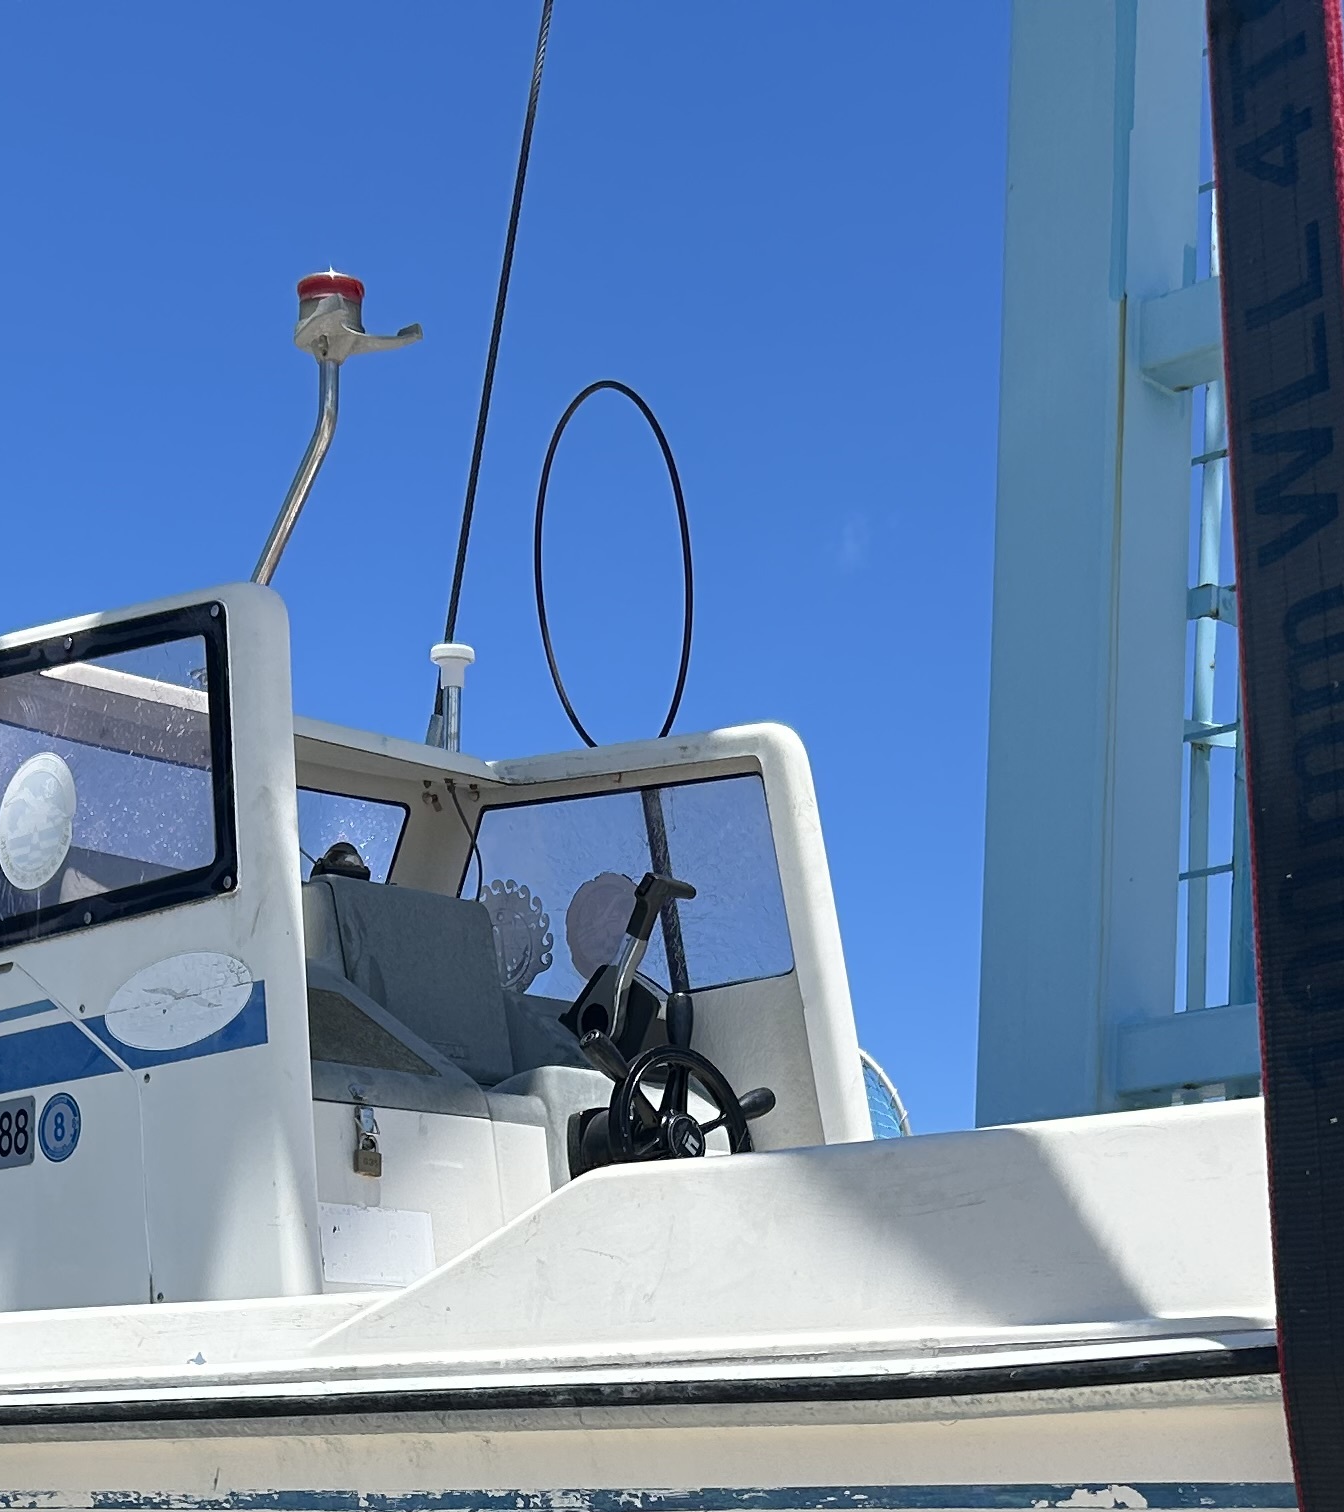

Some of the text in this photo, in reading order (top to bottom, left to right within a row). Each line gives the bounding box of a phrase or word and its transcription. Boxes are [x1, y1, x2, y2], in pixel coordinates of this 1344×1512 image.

[1227, 0, 1314, 190] 4T
[1243, 219, 1339, 568] WLL
[54, 1111, 65, 1142] 8
